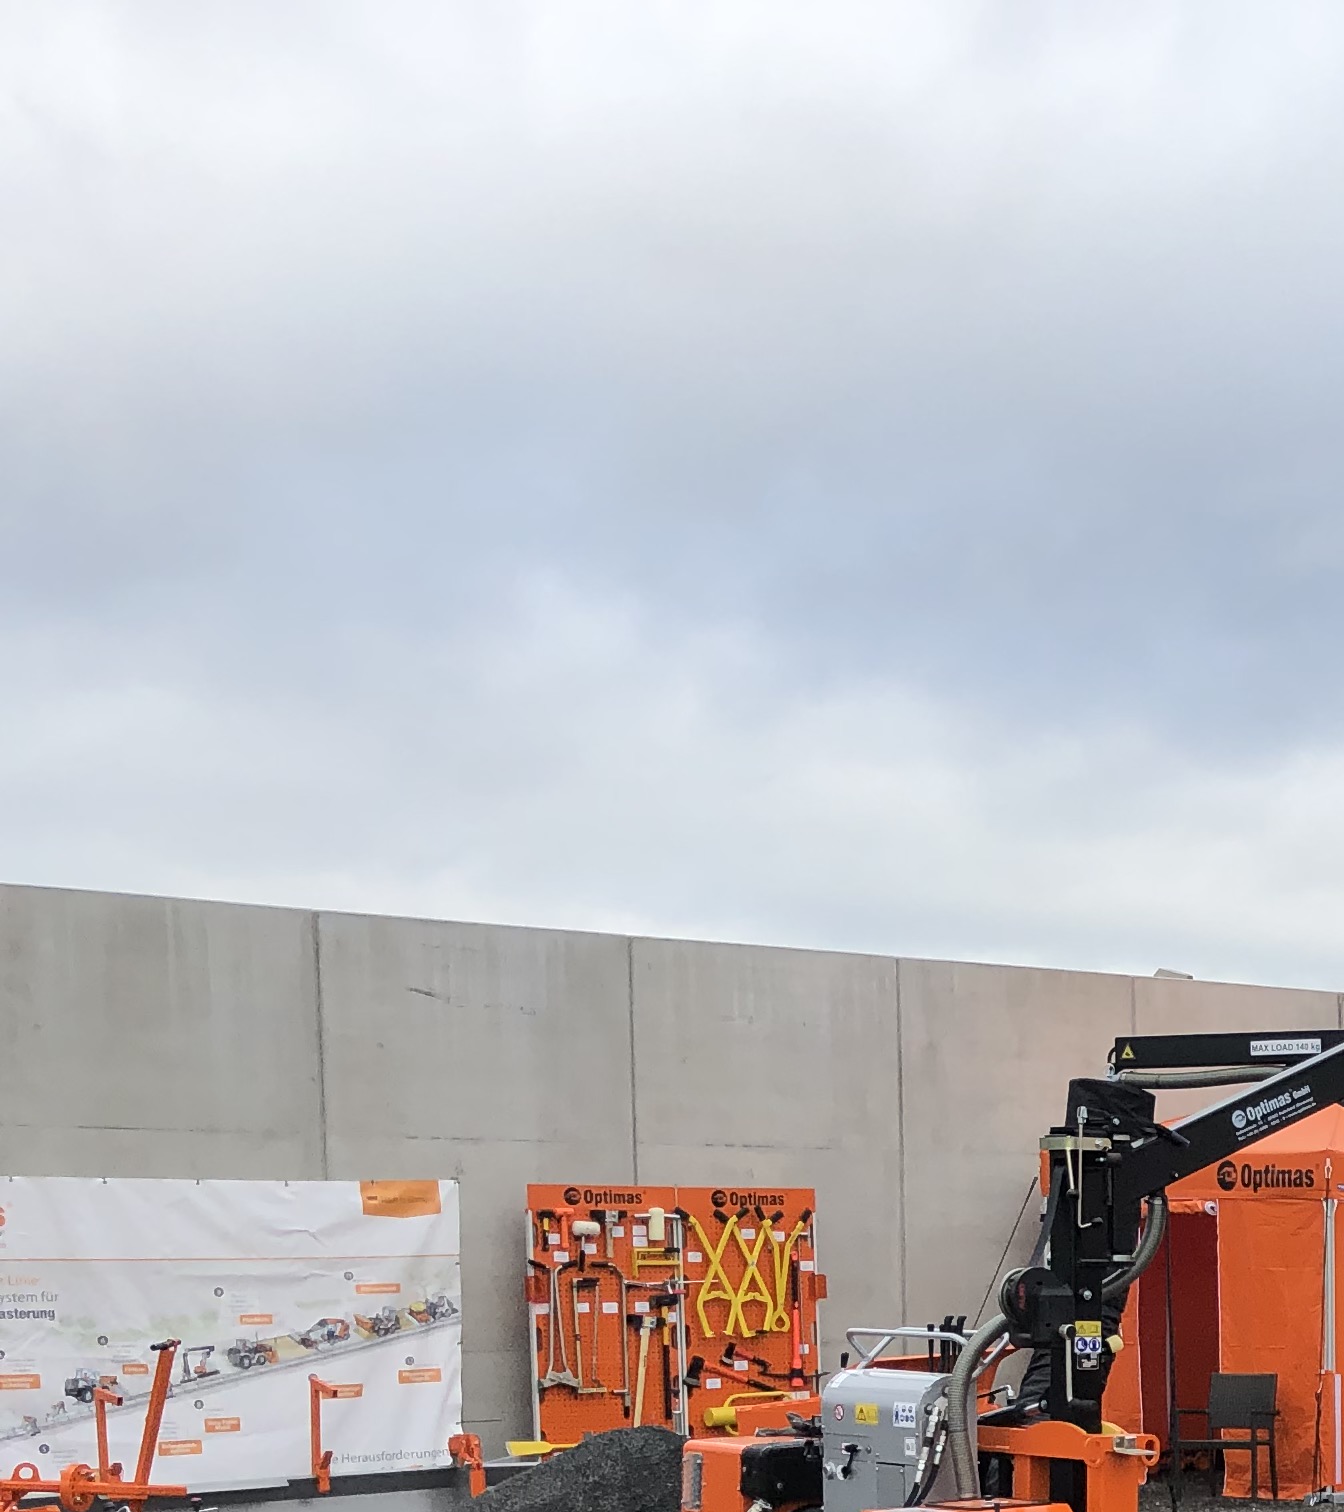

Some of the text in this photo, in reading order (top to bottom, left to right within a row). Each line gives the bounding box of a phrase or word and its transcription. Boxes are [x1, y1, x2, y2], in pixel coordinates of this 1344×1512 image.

[1252, 1044, 1269, 1052] MAX
[1271, 1042, 1294, 1052] LOAD
[1246, 1093, 1292, 1121] Optimas
[1240, 1163, 1315, 1193] Optimas
[583, 1190, 643, 1206] Optimas
[729, 1192, 784, 1207] Optimas
